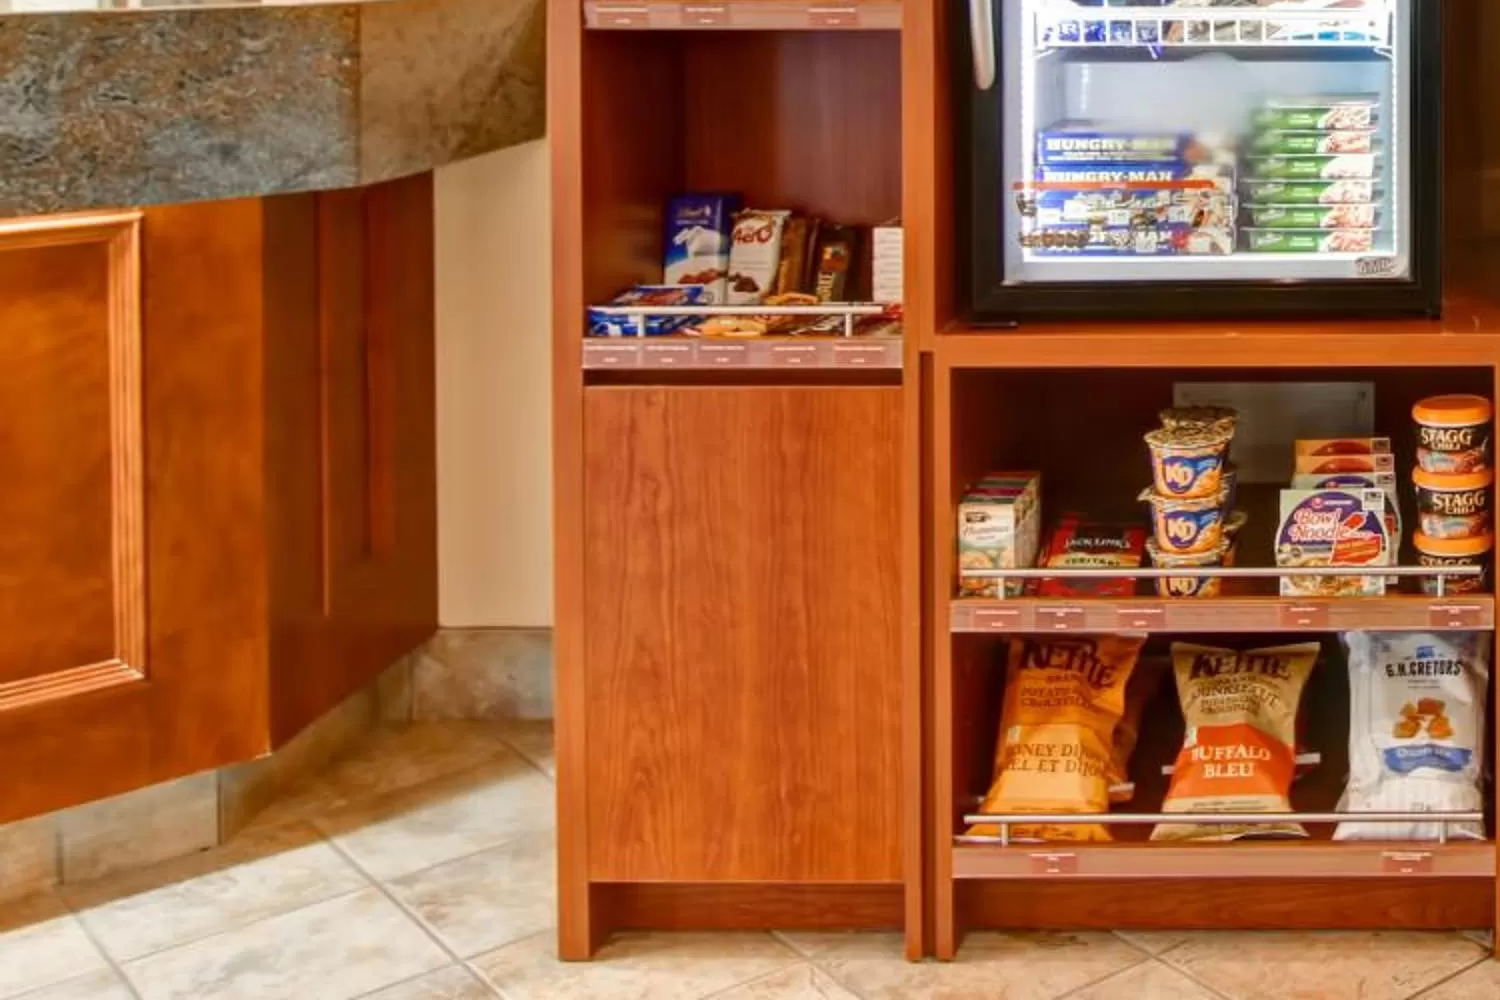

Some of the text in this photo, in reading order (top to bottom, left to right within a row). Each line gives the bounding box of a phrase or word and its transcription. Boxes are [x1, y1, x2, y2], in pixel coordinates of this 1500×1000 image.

[1421, 427, 1474, 446] STAGG
[1164, 462, 1195, 484] KD
[1432, 490, 1486, 509] STAGG
[1166, 517, 1197, 538] KD
[1203, 762, 1256, 779] BLEU
